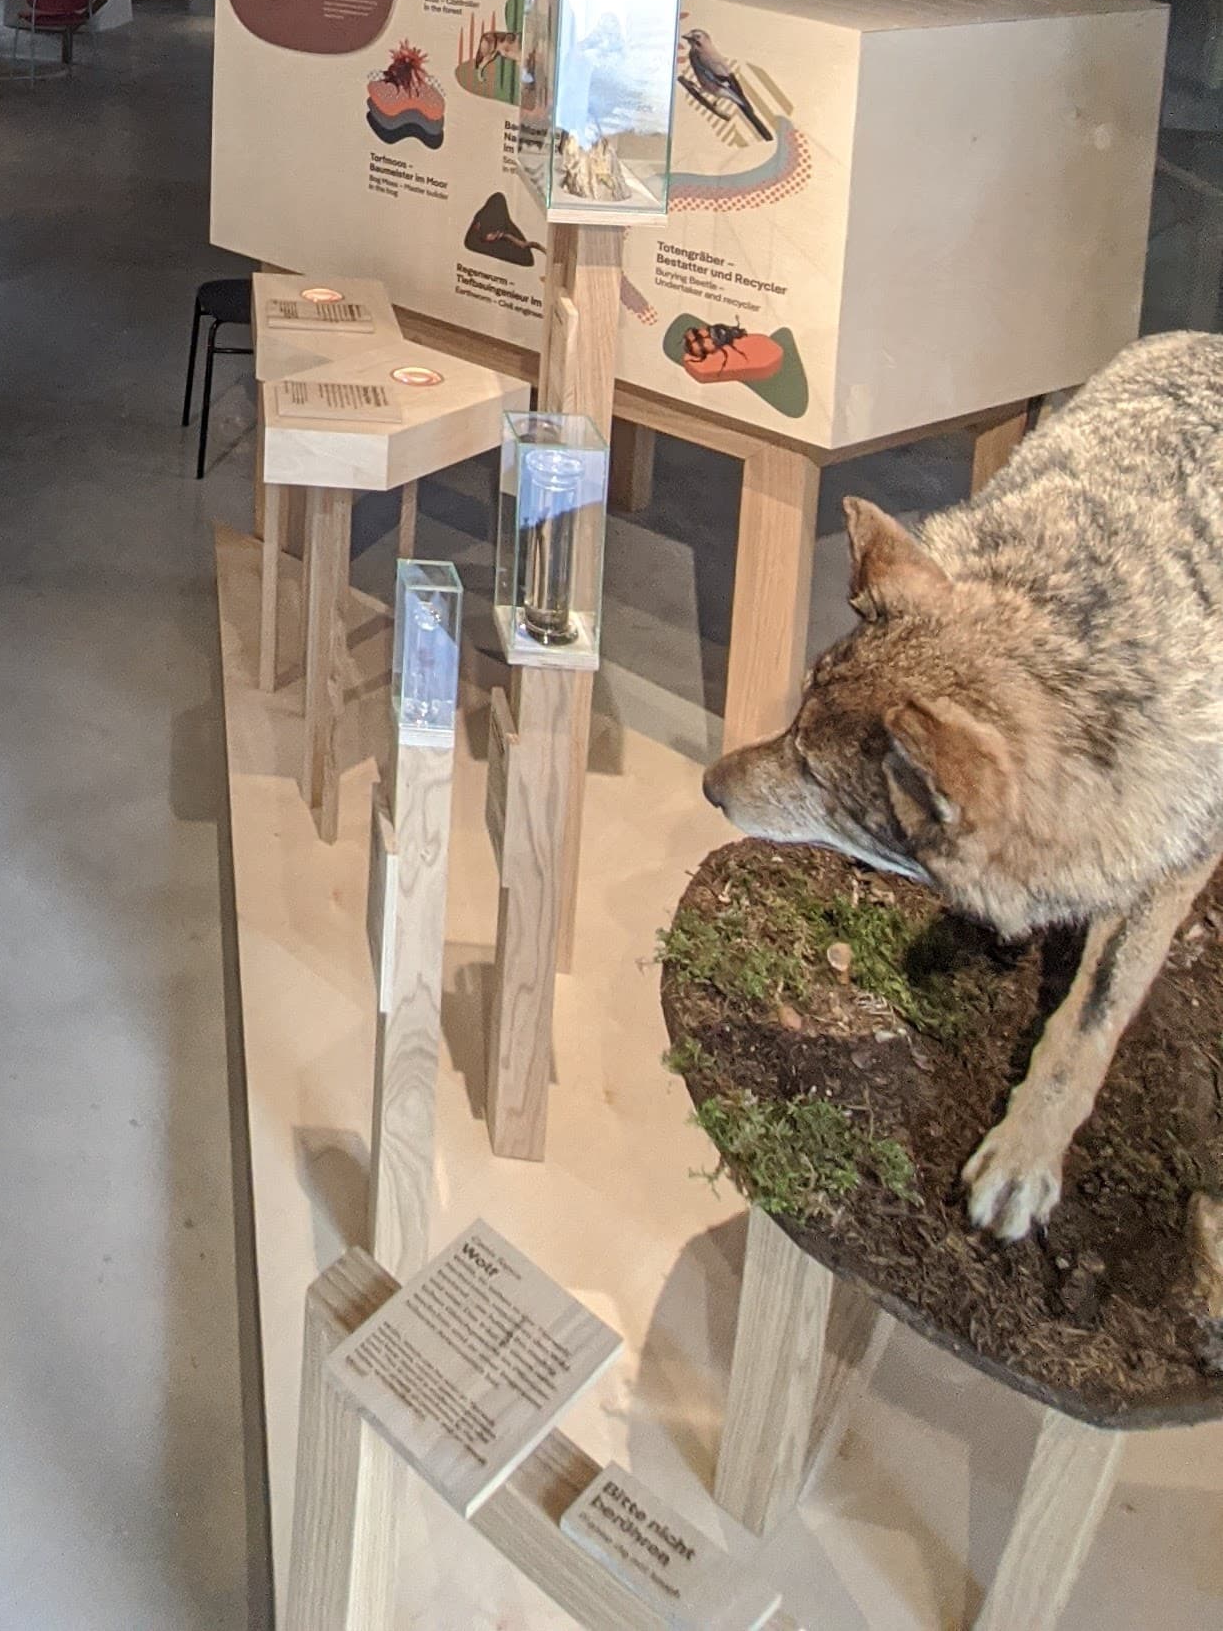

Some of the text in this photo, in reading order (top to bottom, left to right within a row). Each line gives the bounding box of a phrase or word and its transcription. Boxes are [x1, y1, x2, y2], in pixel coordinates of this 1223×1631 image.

[657, 240, 725, 267] Totengräber
[657, 253, 788, 295] Bestatter und Recycler
[462, 1243, 498, 1276] Wolf
[590, 1495, 670, 1567] berühren
[603, 1481, 646, 1522] Bitte
[647, 1520, 695, 1561] nicht
